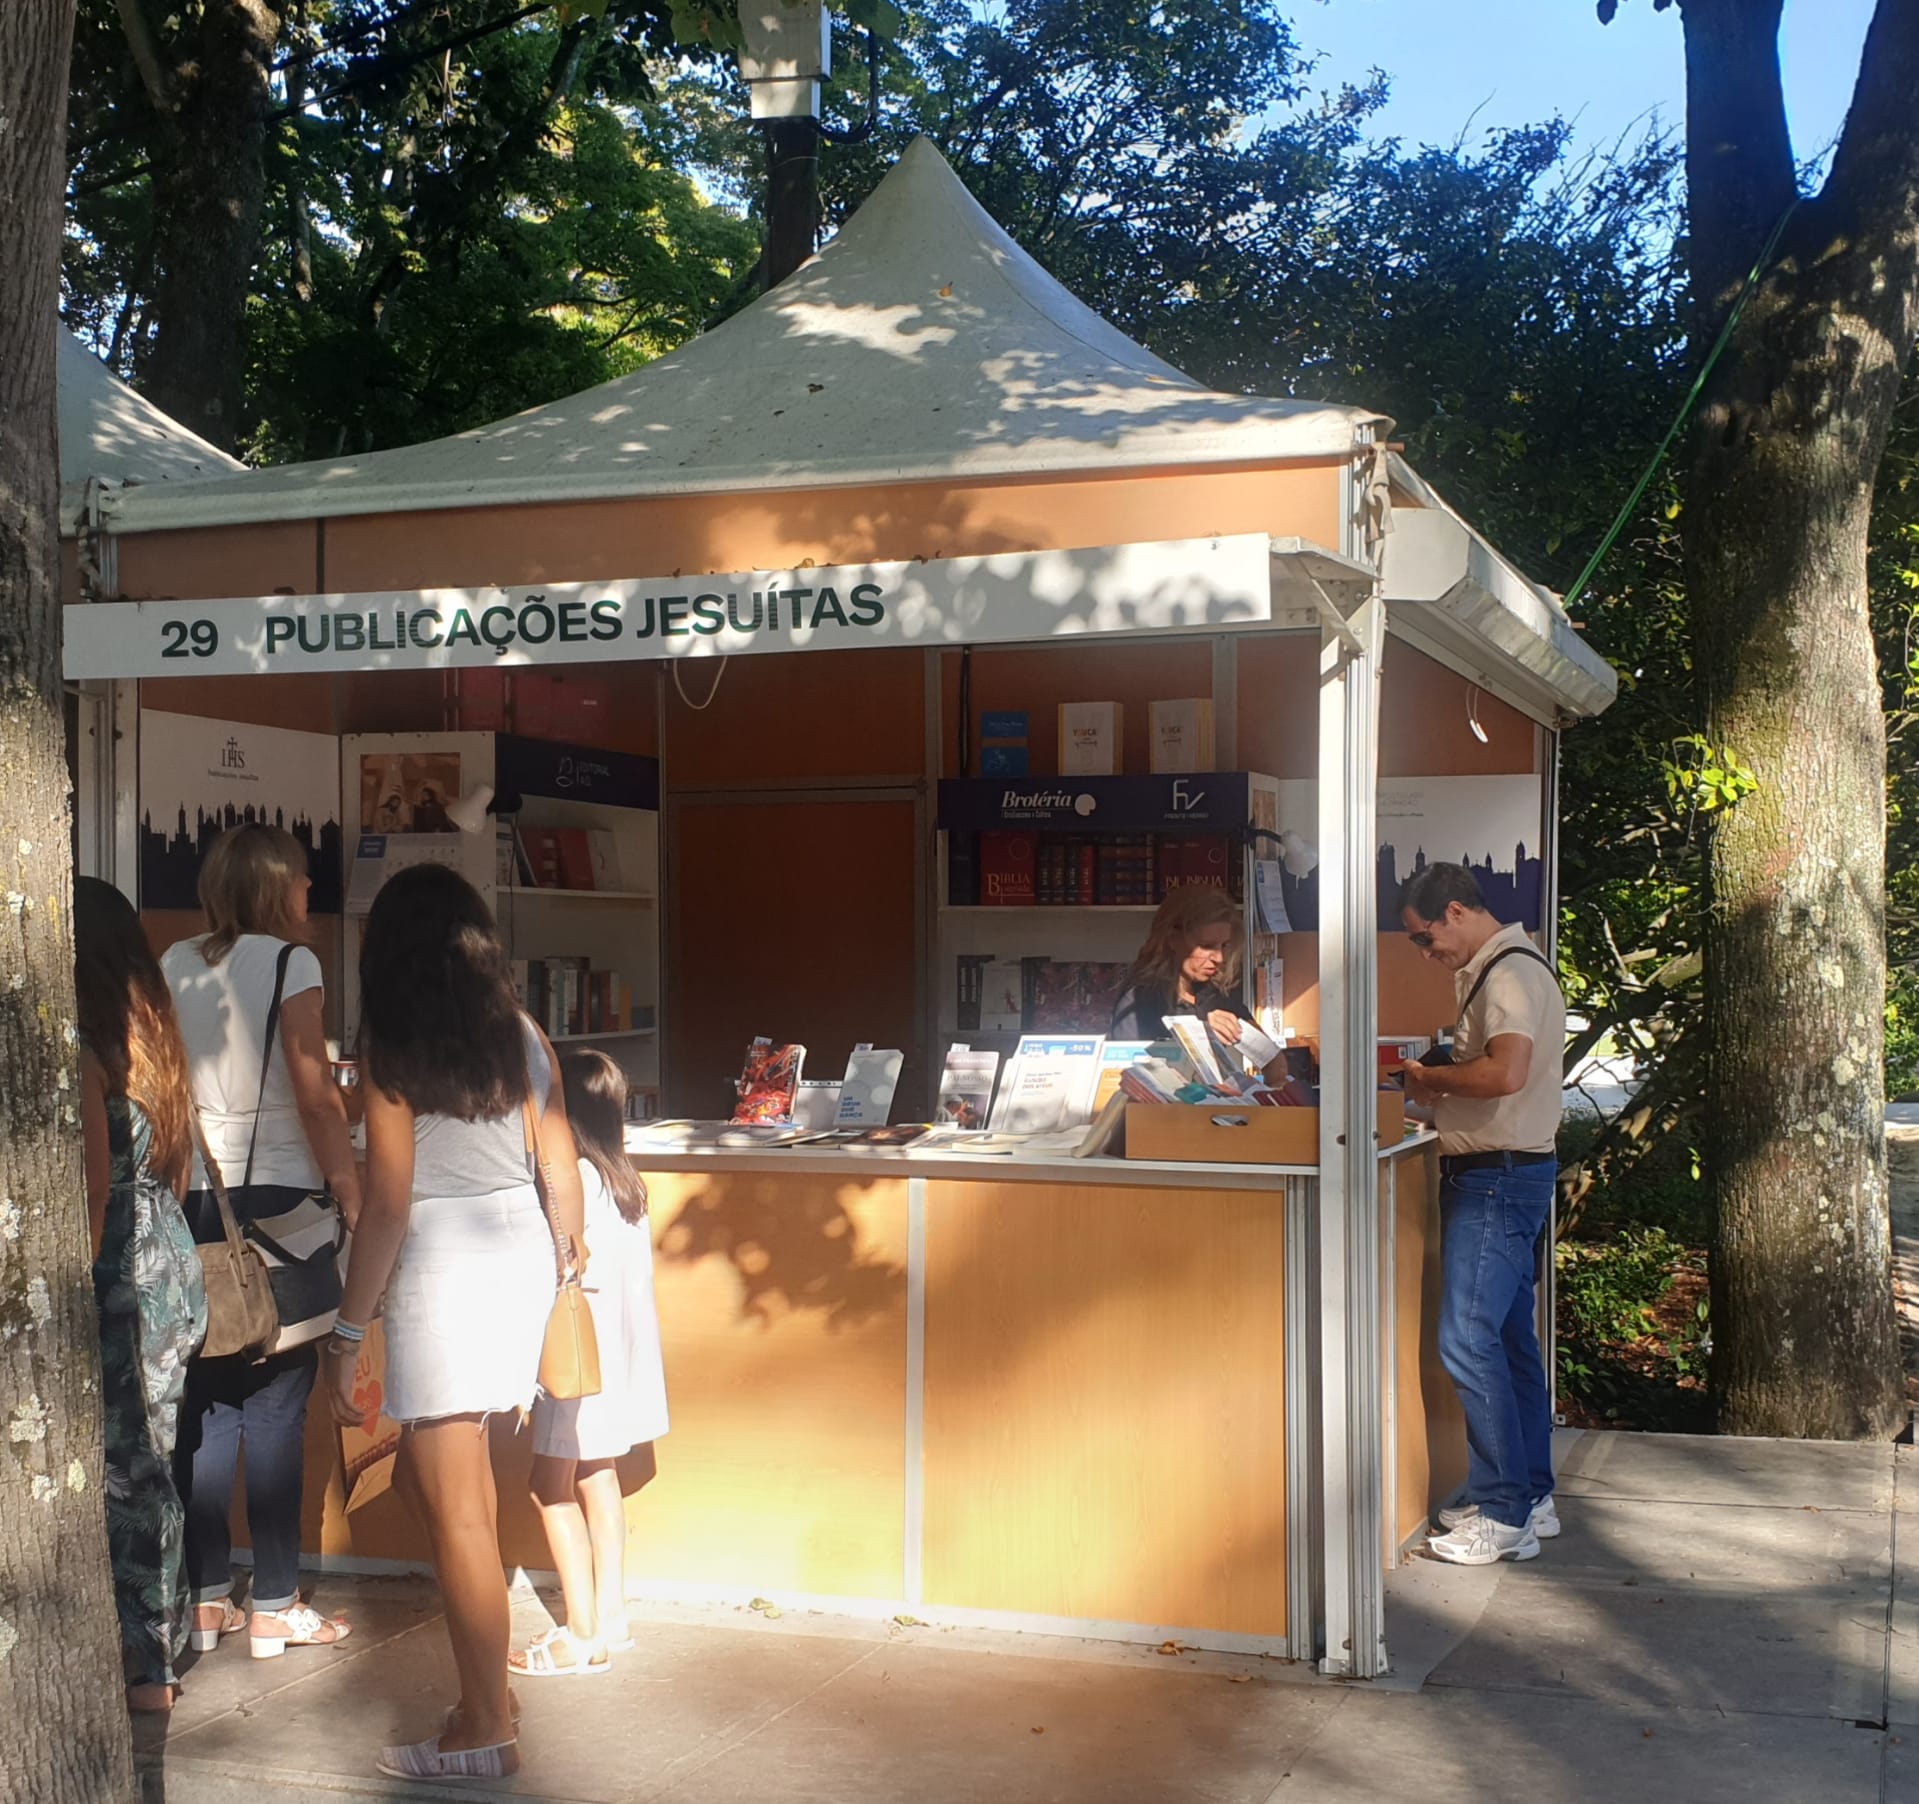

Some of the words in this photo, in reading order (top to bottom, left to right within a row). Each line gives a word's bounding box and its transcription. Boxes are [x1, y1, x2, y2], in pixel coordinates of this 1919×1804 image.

[161, 619, 219, 658] 29
[266, 594, 623, 655] PUBLICAÇÕES
[637, 583, 885, 639] JESUÍTAS
[1001, 789, 1072, 809] Brotéria
